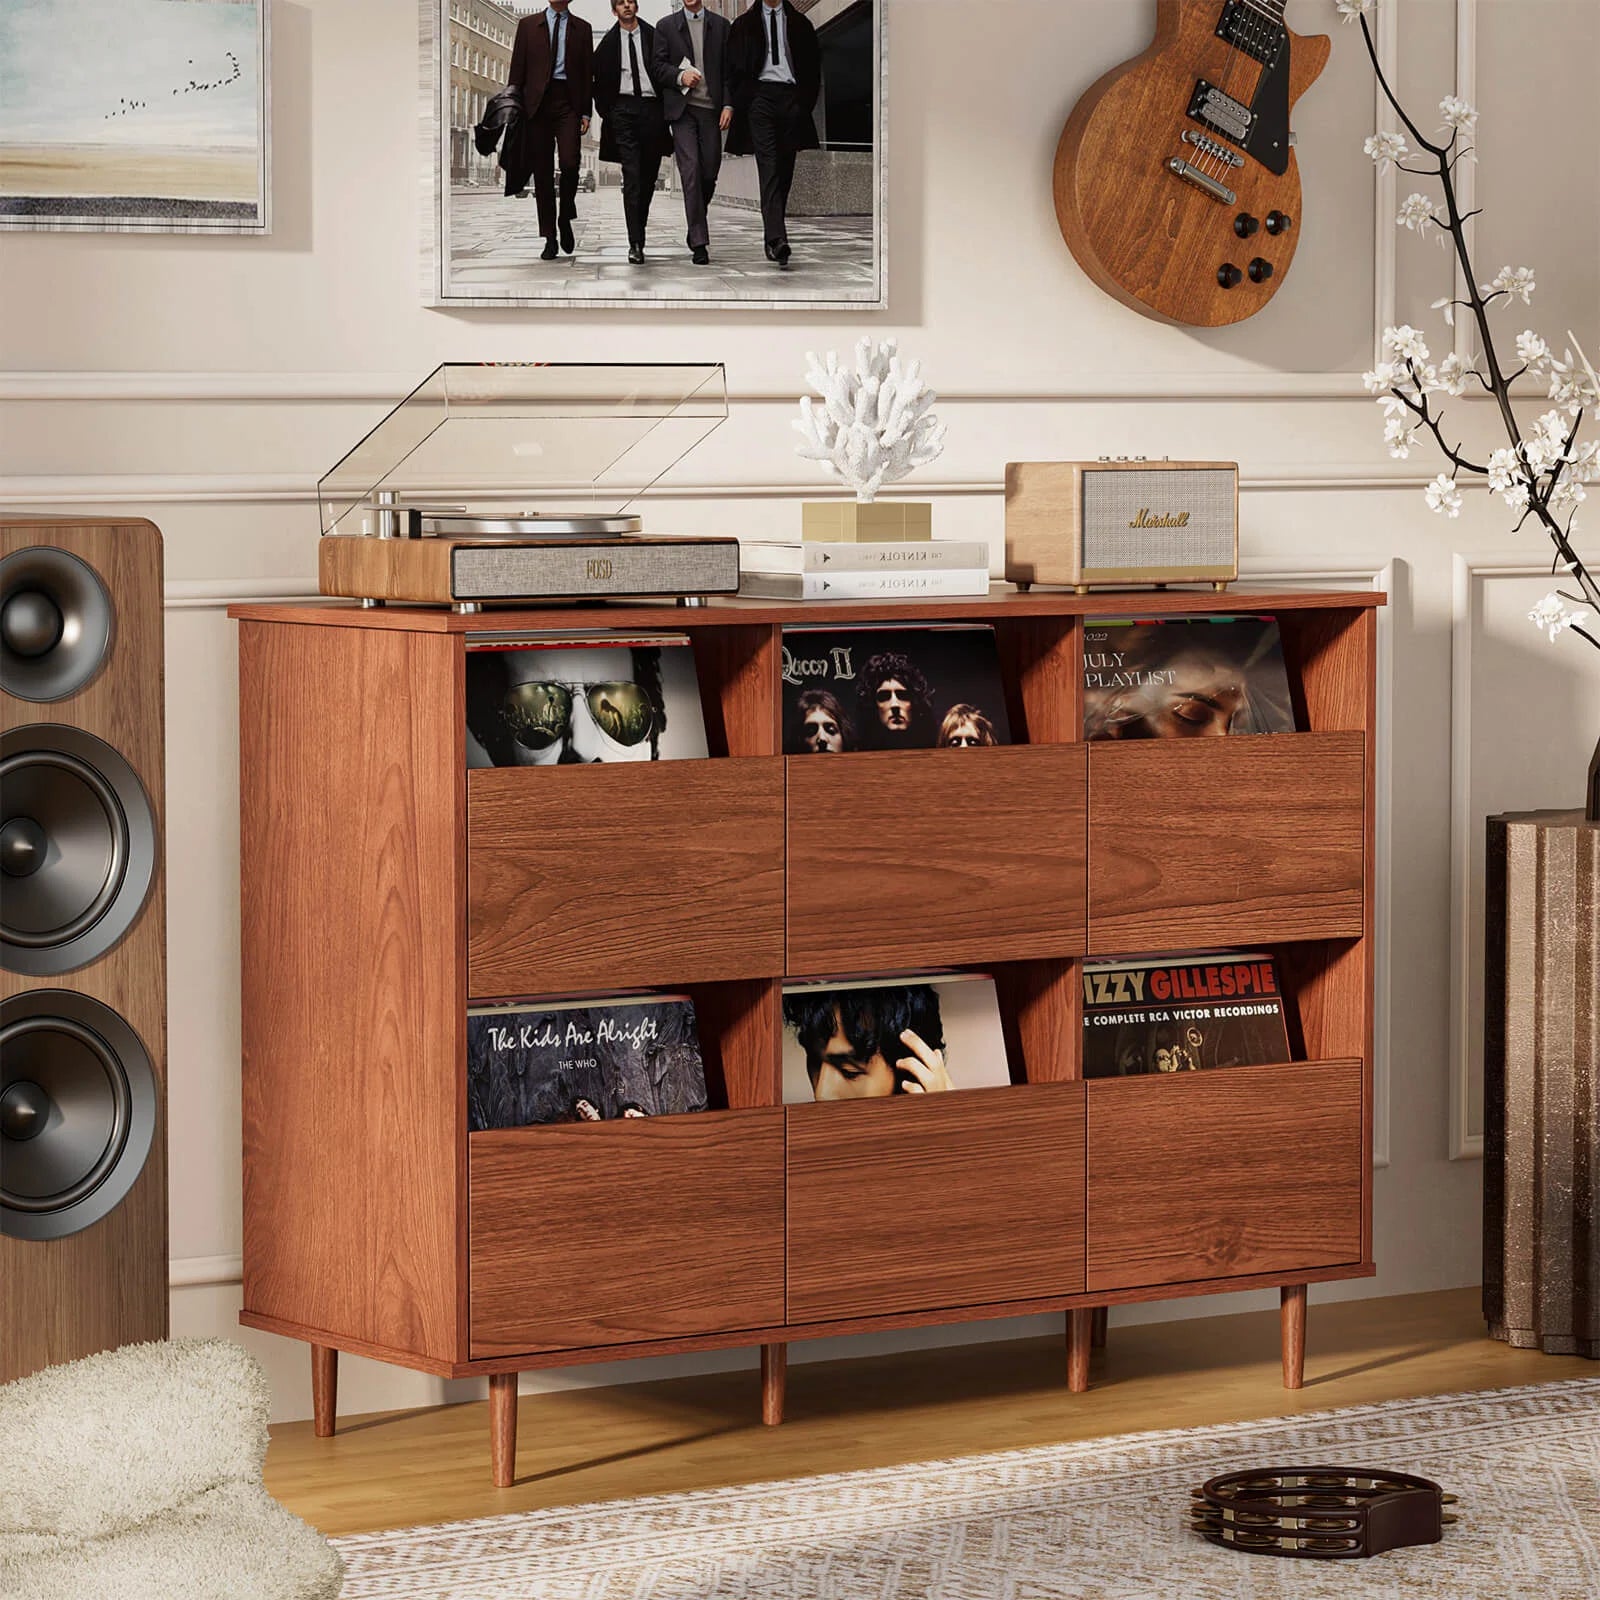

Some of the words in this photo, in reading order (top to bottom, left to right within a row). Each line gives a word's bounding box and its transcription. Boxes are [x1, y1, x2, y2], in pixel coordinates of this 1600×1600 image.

[1129, 508, 1190, 528] Marshall
[1084, 632, 1108, 641] 022
[1083, 652, 1125, 670] JULY
[1086, 670, 1176, 688] PLAYLIST
[1083, 971, 1146, 1004] IZZY
[1150, 963, 1276, 1000] GILLESPIE
[1093, 1013, 1146, 1026] COMPLETE
[1149, 1011, 1170, 1022] RCA
[1173, 1008, 1211, 1021] VICTOR
[1214, 1004, 1279, 1018] RECORDINGS
[487, 1027, 517, 1052] The
[520, 1023, 562, 1049] Kids
[564, 1021, 594, 1048] Are
[558, 1060, 574, 1070] THE
[575, 1058, 597, 1069] WHO
